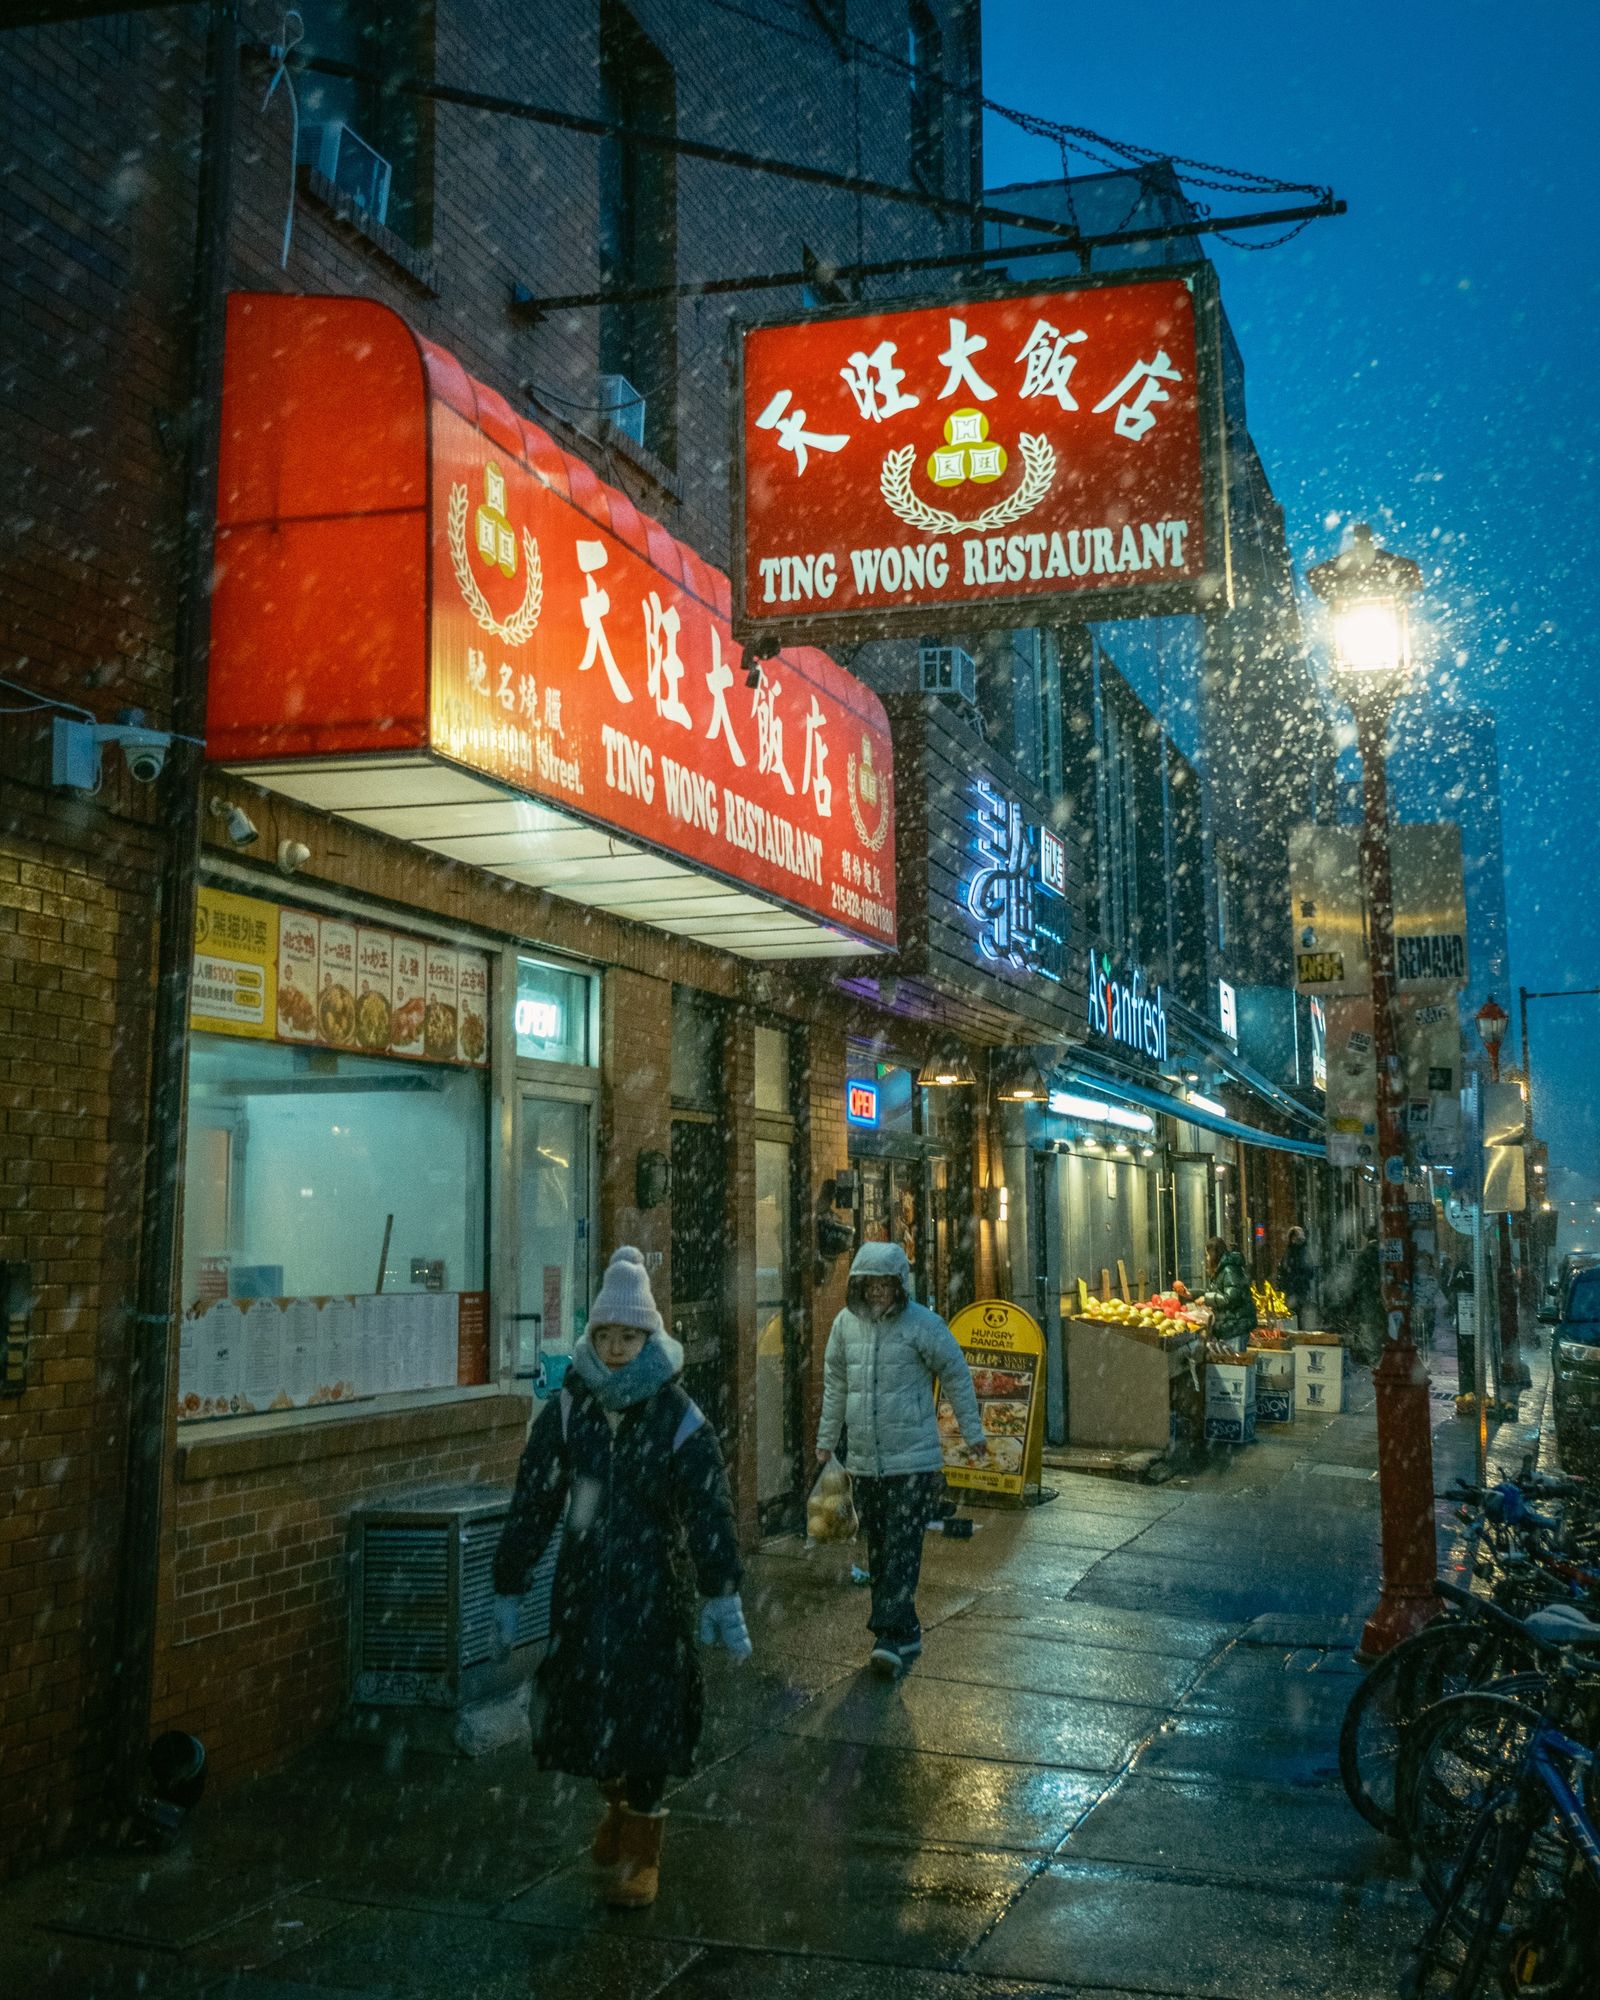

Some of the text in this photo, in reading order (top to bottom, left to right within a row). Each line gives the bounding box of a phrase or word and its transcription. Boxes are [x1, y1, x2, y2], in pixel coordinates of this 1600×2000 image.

[756, 319, 1182, 477] 天旺大飯店
[759, 520, 1188, 603] TING WONG RESTAURANT
[577, 540, 832, 818] 天旺大飯店
[602, 723, 823, 886] TING WONG RESTAURANT
[970, 1337, 1006, 1348] PANDA
[971, 1328, 1015, 1341] HUNGRY
